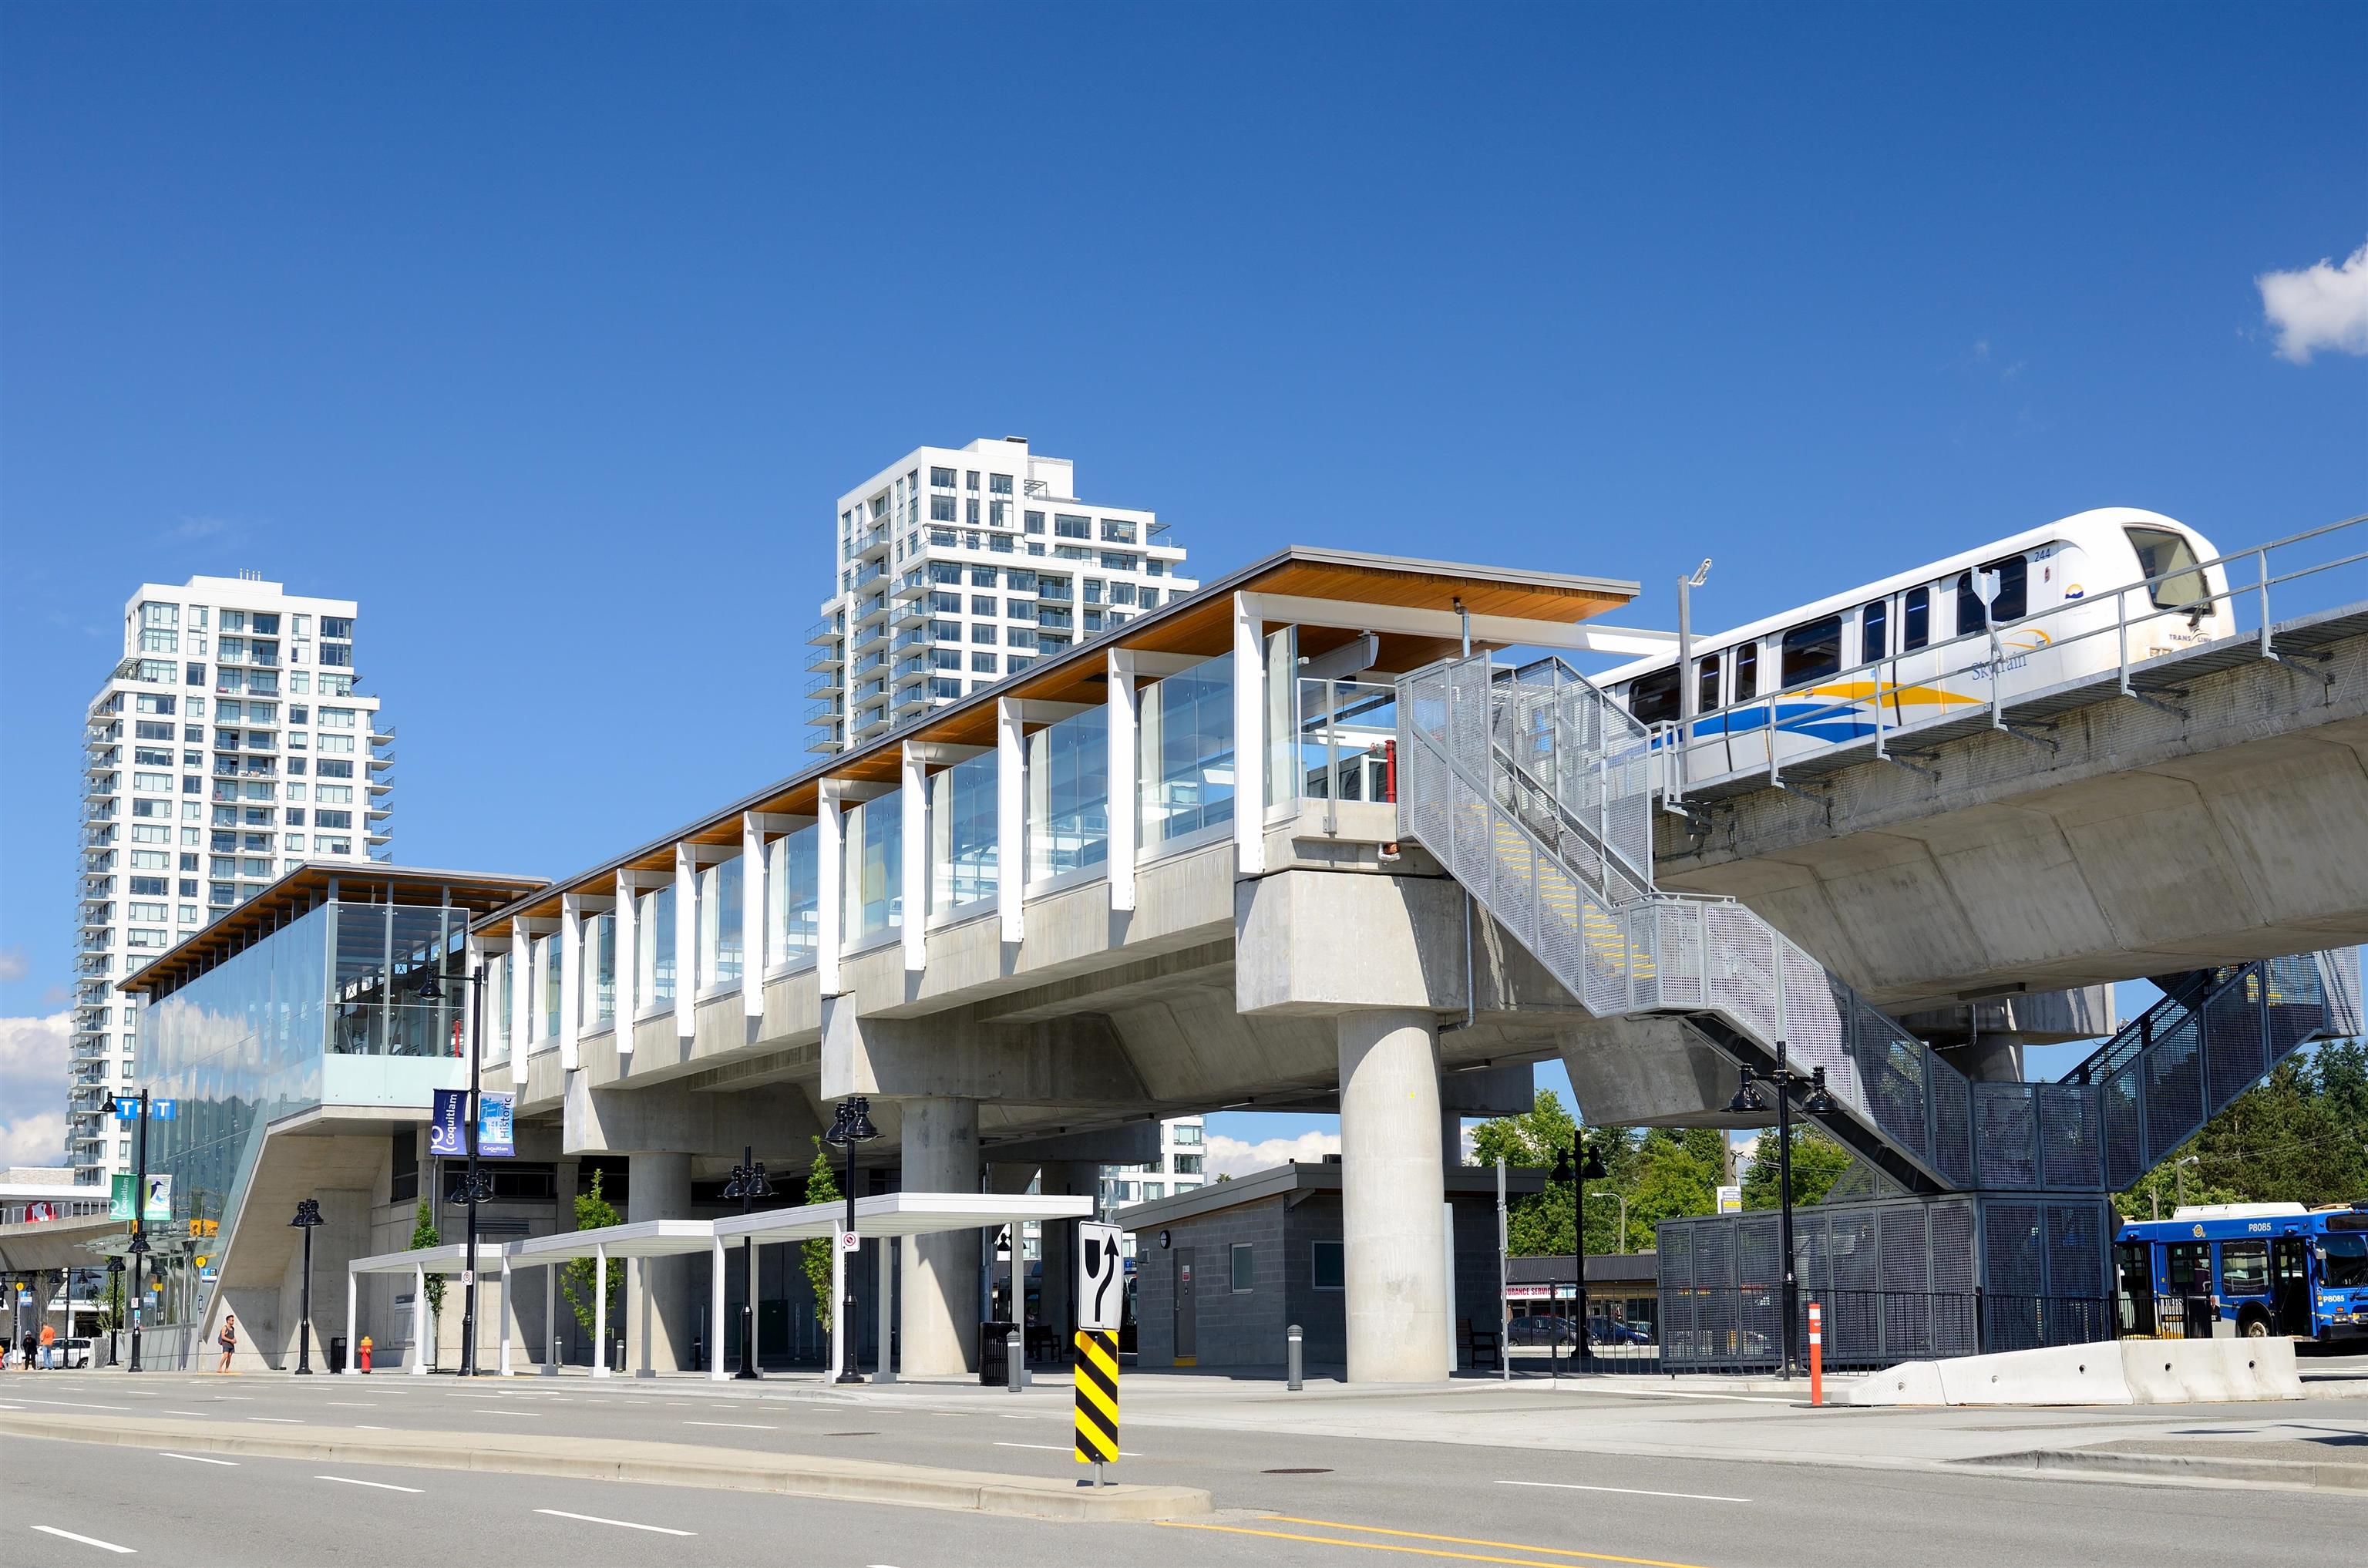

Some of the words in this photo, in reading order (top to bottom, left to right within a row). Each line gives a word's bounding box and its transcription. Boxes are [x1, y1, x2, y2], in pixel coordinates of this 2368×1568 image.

[2035, 548, 2050, 562] 244
[1972, 651, 2027, 681] Skyrain
[121, 1101, 133, 1115] T
[156, 1102, 170, 1116] T
[446, 1094, 457, 1145] Coquitlam
[500, 1098, 512, 1138] Historic
[120, 1177, 130, 1213] Coquitlam
[2249, 1223, 2272, 1232] P8085
[1505, 1287, 1529, 1296] URANCE
[1531, 1287, 1558, 1296] SERVICS
